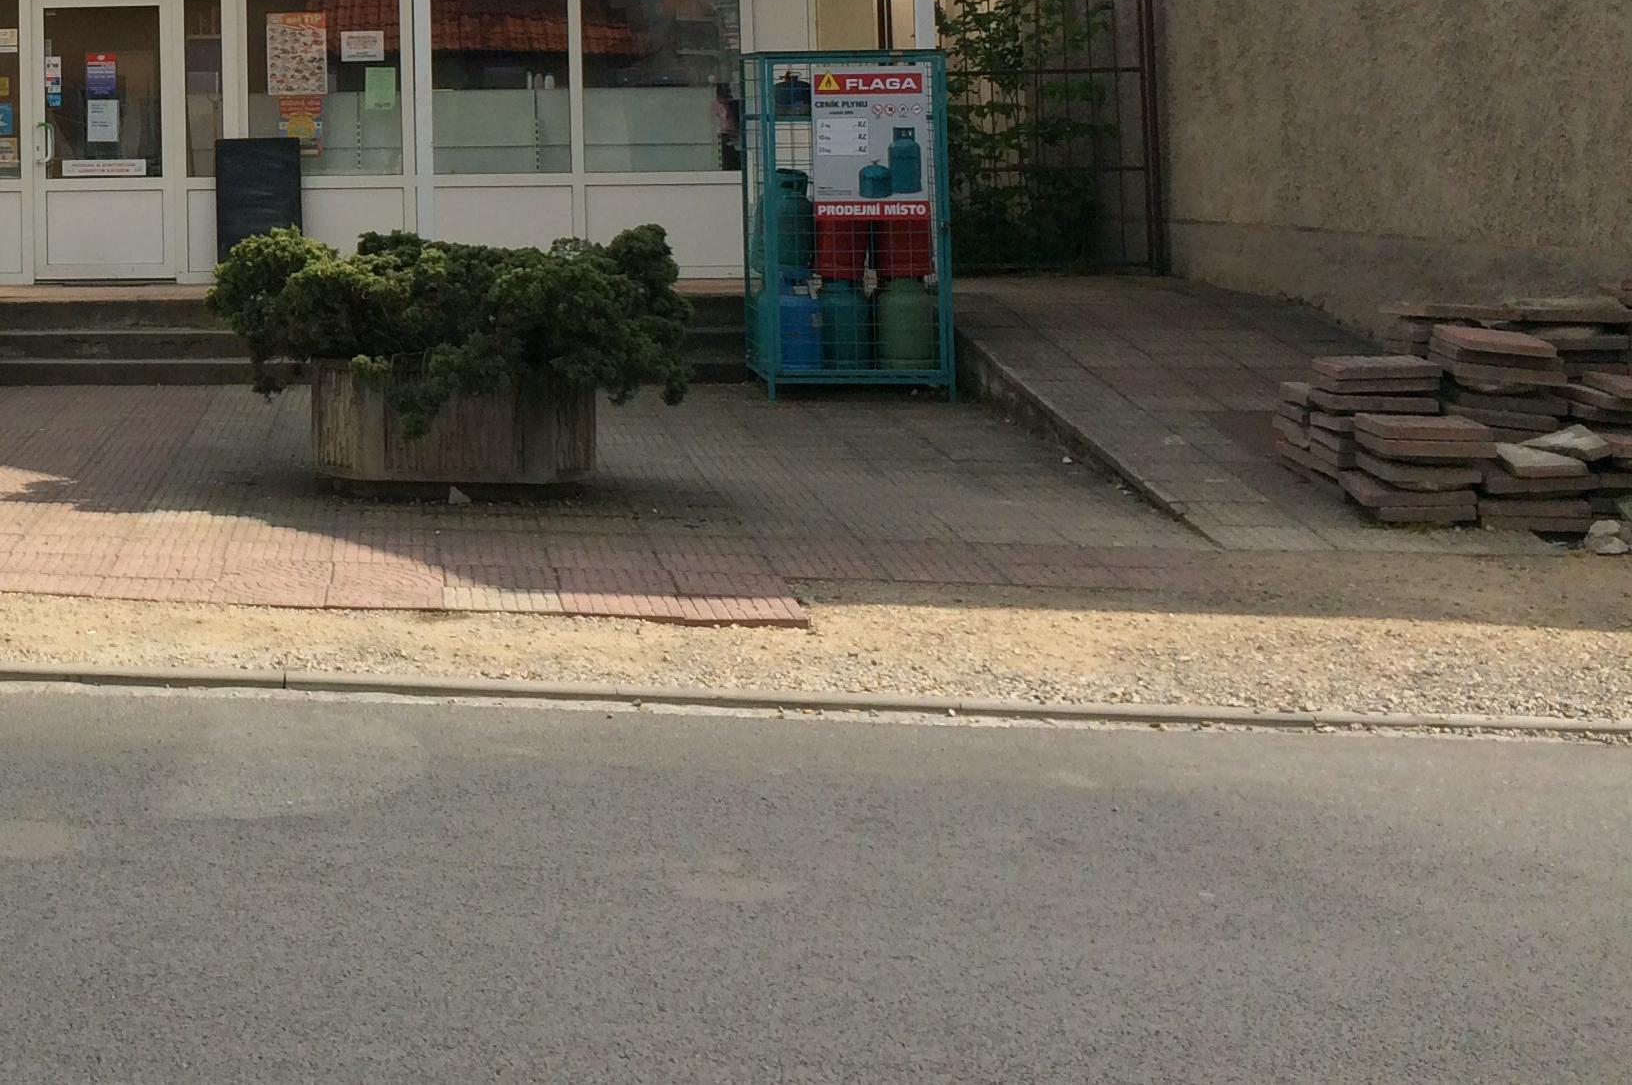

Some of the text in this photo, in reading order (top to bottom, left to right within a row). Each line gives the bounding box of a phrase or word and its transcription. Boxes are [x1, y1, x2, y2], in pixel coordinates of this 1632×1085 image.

[845, 78, 917, 91] FLAGA
[814, 99, 839, 109] CENÍK
[818, 202, 927, 216] PRODEJNÍ MÍSTO
